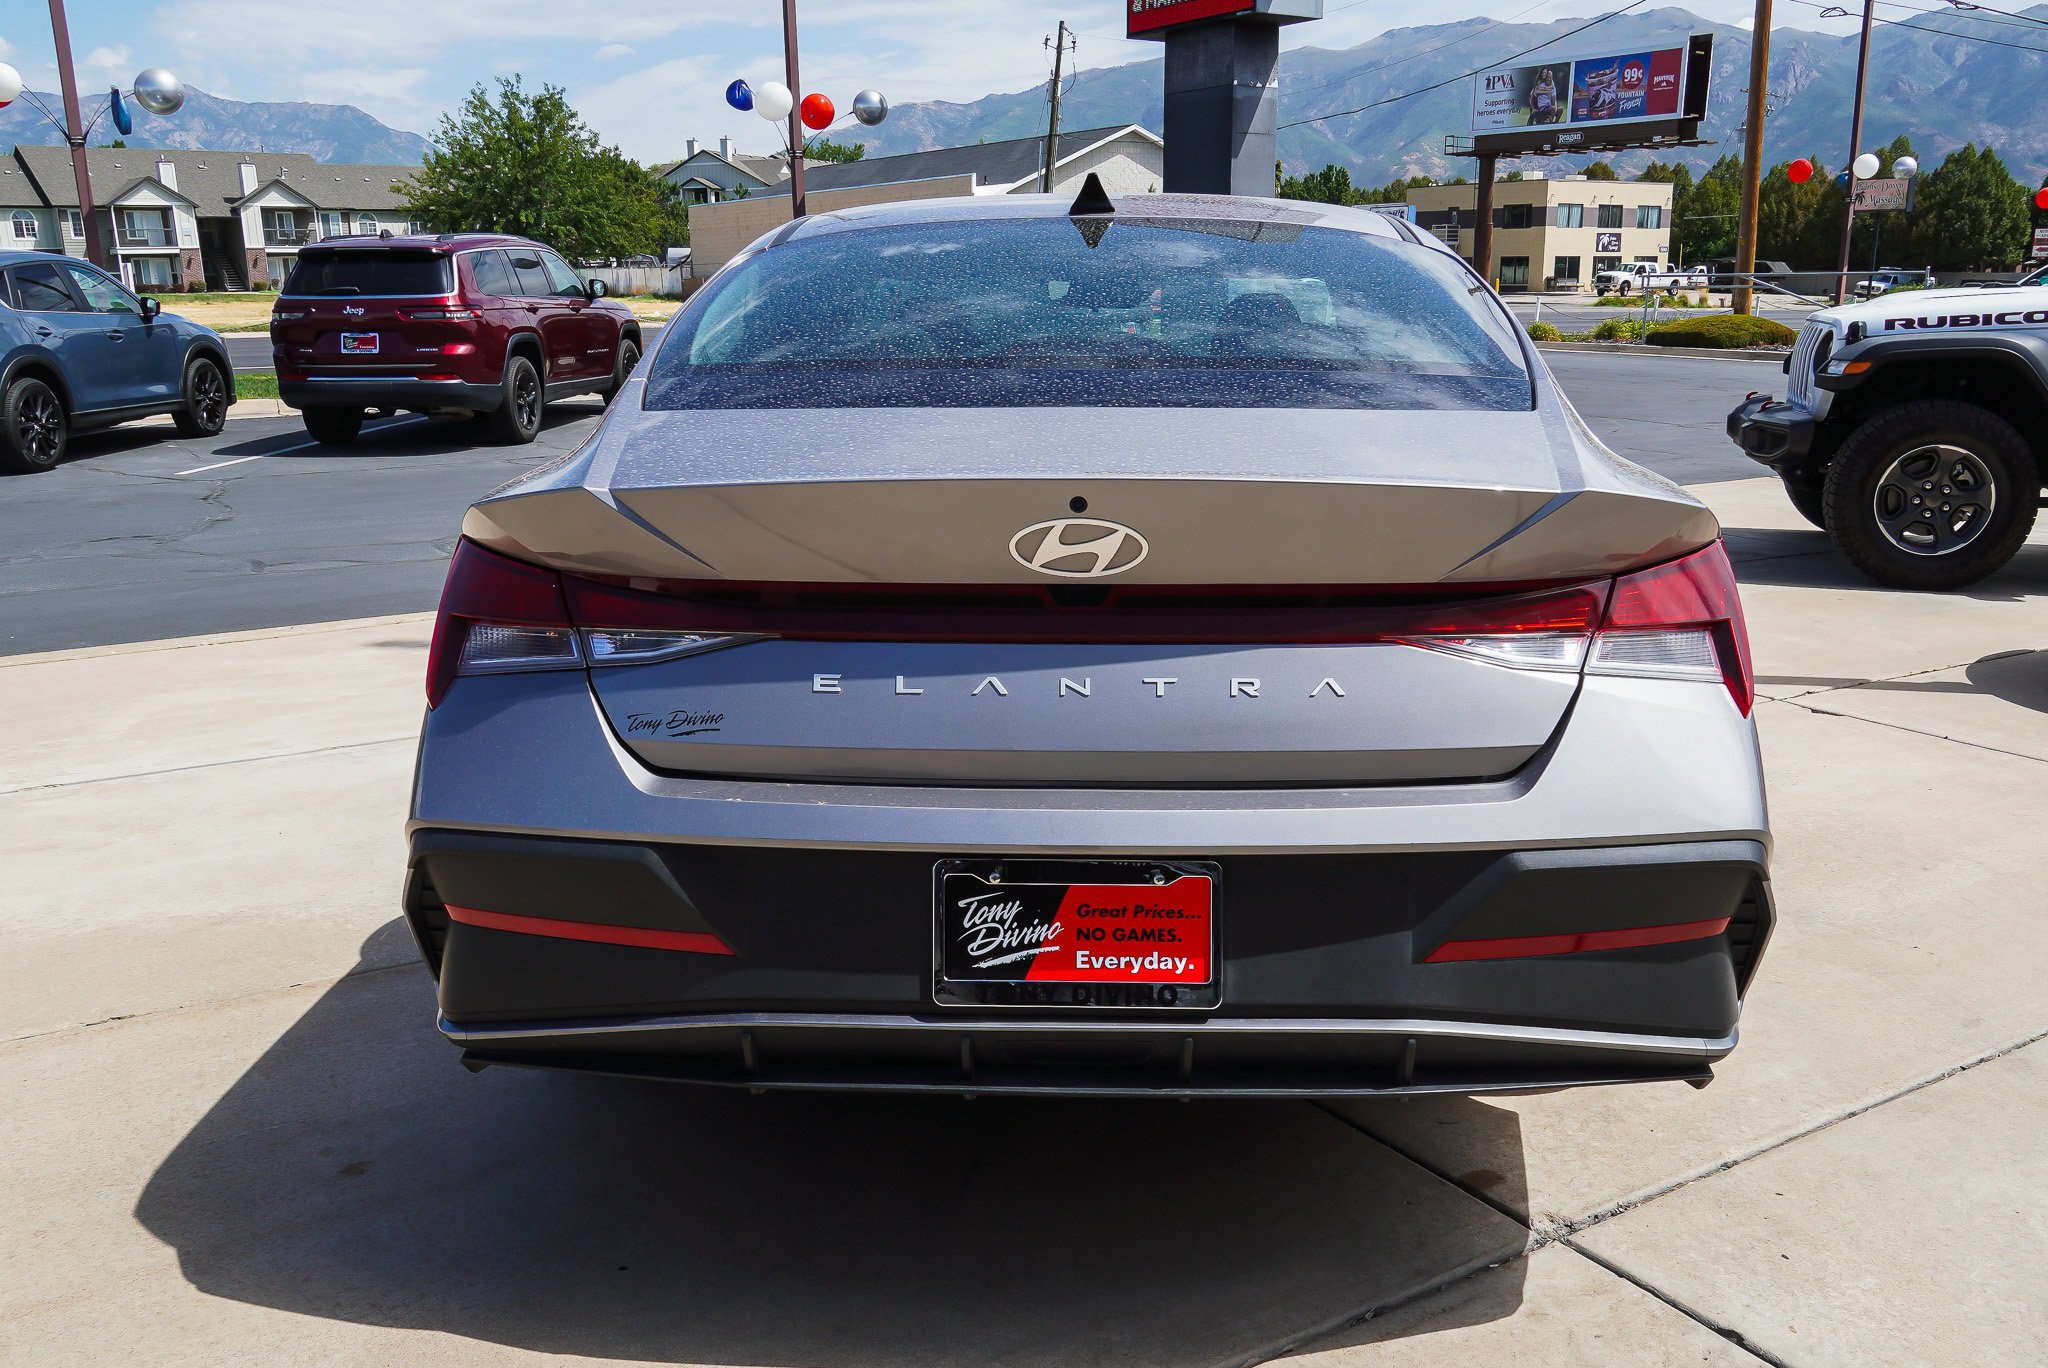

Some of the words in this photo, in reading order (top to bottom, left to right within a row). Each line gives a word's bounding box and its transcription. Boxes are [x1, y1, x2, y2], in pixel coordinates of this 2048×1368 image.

[1492, 73, 1515, 90] PVA
[1624, 68, 1643, 82] 99¢
[1485, 98, 1514, 107] Supporting
[1618, 90, 1645, 99] FOUNTAIN
[1477, 108, 1496, 117] heroes
[1496, 106, 1522, 116] everyday
[1558, 133, 1581, 143] Reagan
[1881, 182, 1904, 192] Down
[343, 305, 364, 315] Jeep
[812, 673, 1346, 698] ELANTRA
[627, 714, 664, 734] Tony
[665, 708, 726, 730] Divino
[957, 891, 1024, 928] Tony
[1077, 904, 1127, 918] Great
[1133, 903, 1201, 919] Prices...
[957, 918, 1065, 956] Divino
[1076, 927, 1106, 942] NO
[1112, 927, 1183, 943] GAMES.
[1076, 950, 1195, 974] Everyday.
